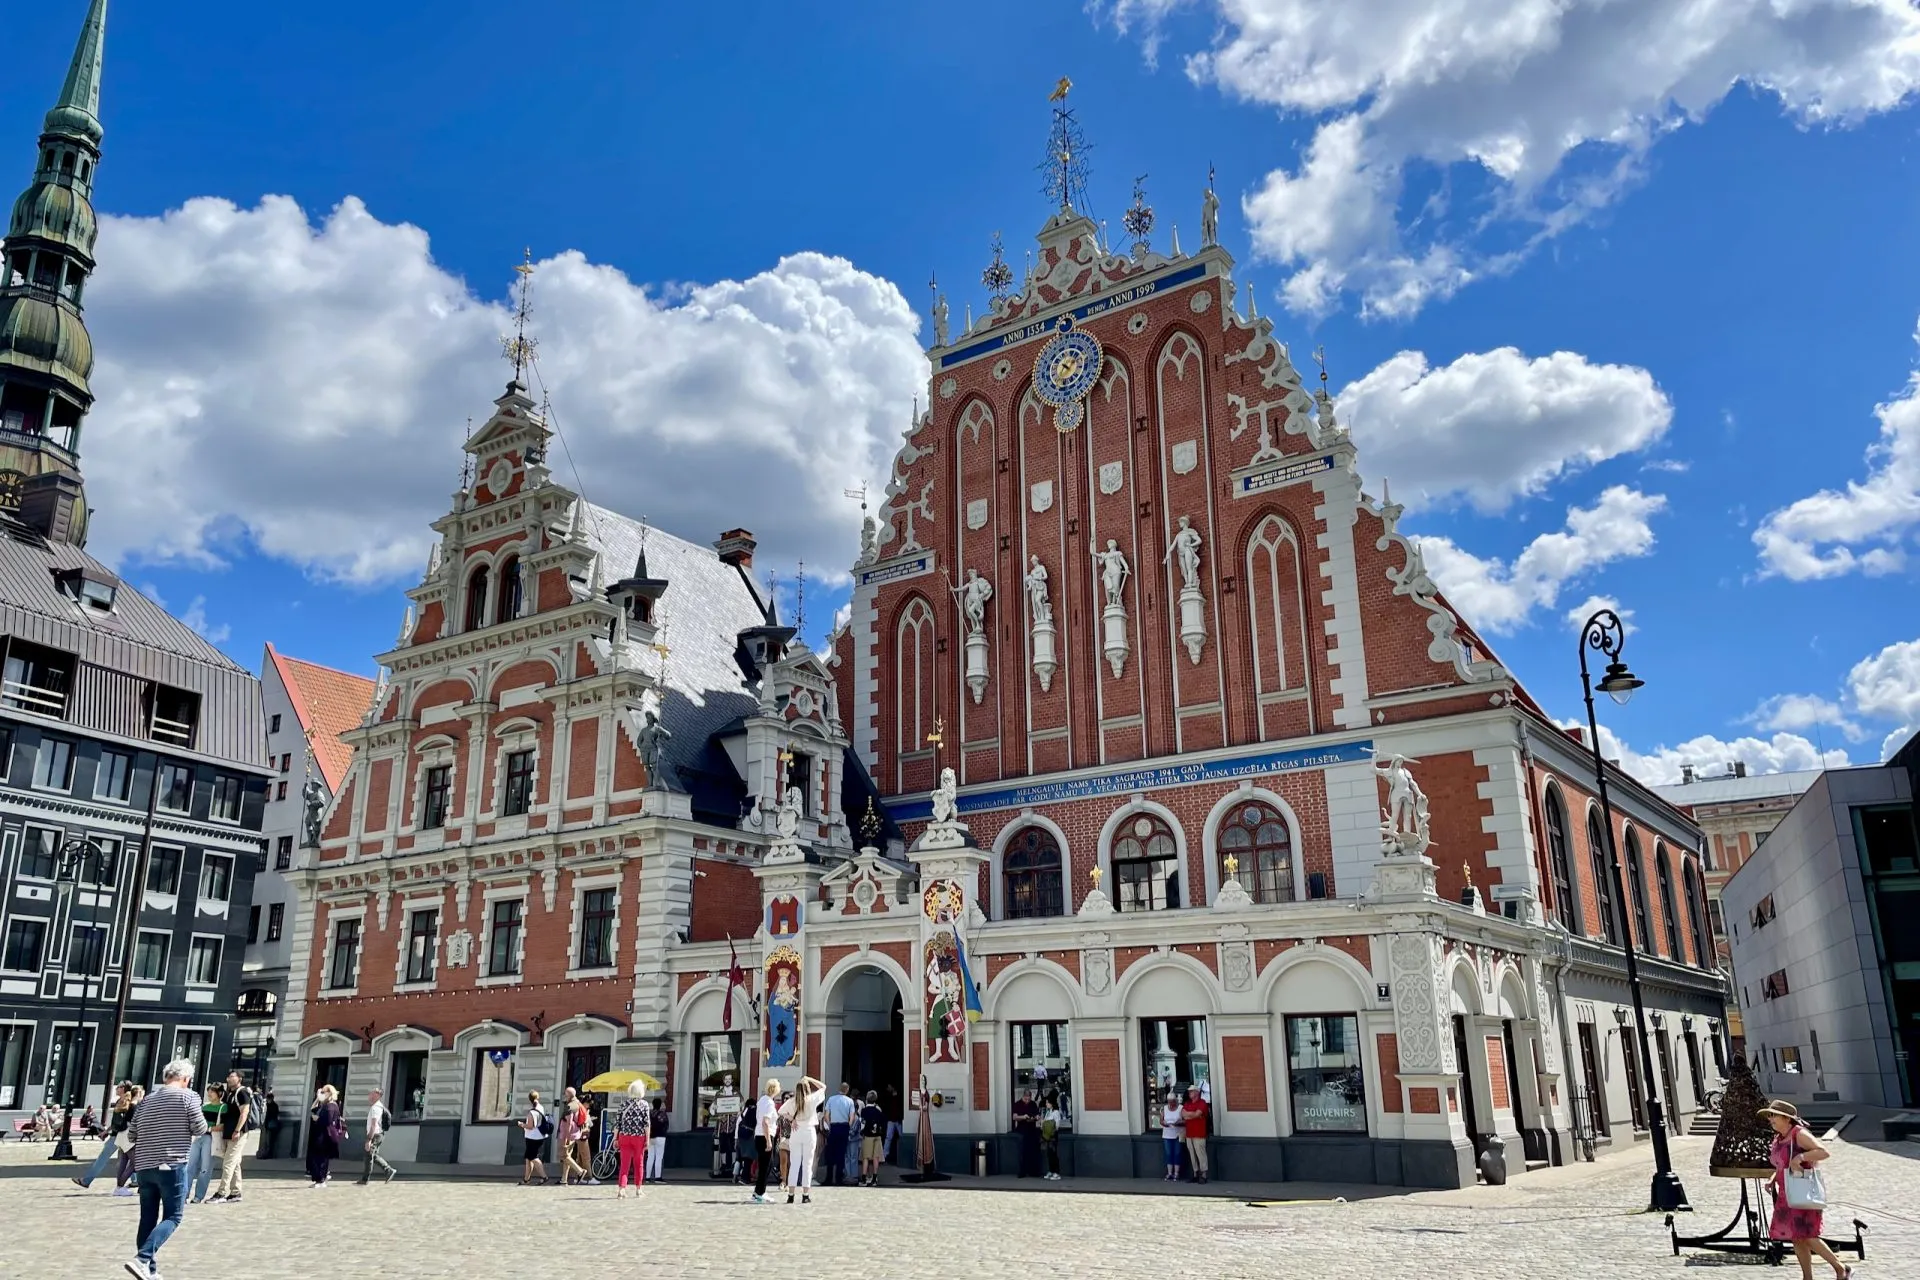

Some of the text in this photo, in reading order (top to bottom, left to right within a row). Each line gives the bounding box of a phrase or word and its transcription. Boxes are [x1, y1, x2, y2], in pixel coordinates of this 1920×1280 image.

[1109, 290, 1133, 308] ANNO
[1136, 282, 1155, 298] 1999
[1002, 321, 1045, 345] ANNO 1334
[1012, 796, 1026, 805] PAR
[1028, 793, 1050, 802] GODU
[1054, 789, 1078, 798] NAMU
[1081, 787, 1093, 795] UZ
[1138, 775, 1181, 788] PAMATIEM
[1184, 773, 1198, 782] NO
[1201, 769, 1229, 781] JAUNA
[1068, 781, 1089, 790] NAMS
[1092, 777, 1111, 787] TIKA
[1115, 772, 1155, 783] SAGRAUTS
[1380, 987, 1386, 996] 7
[46, 1034, 62, 1105] FOR SALE
[1303, 1107, 1356, 1118] SOUVENIRS
